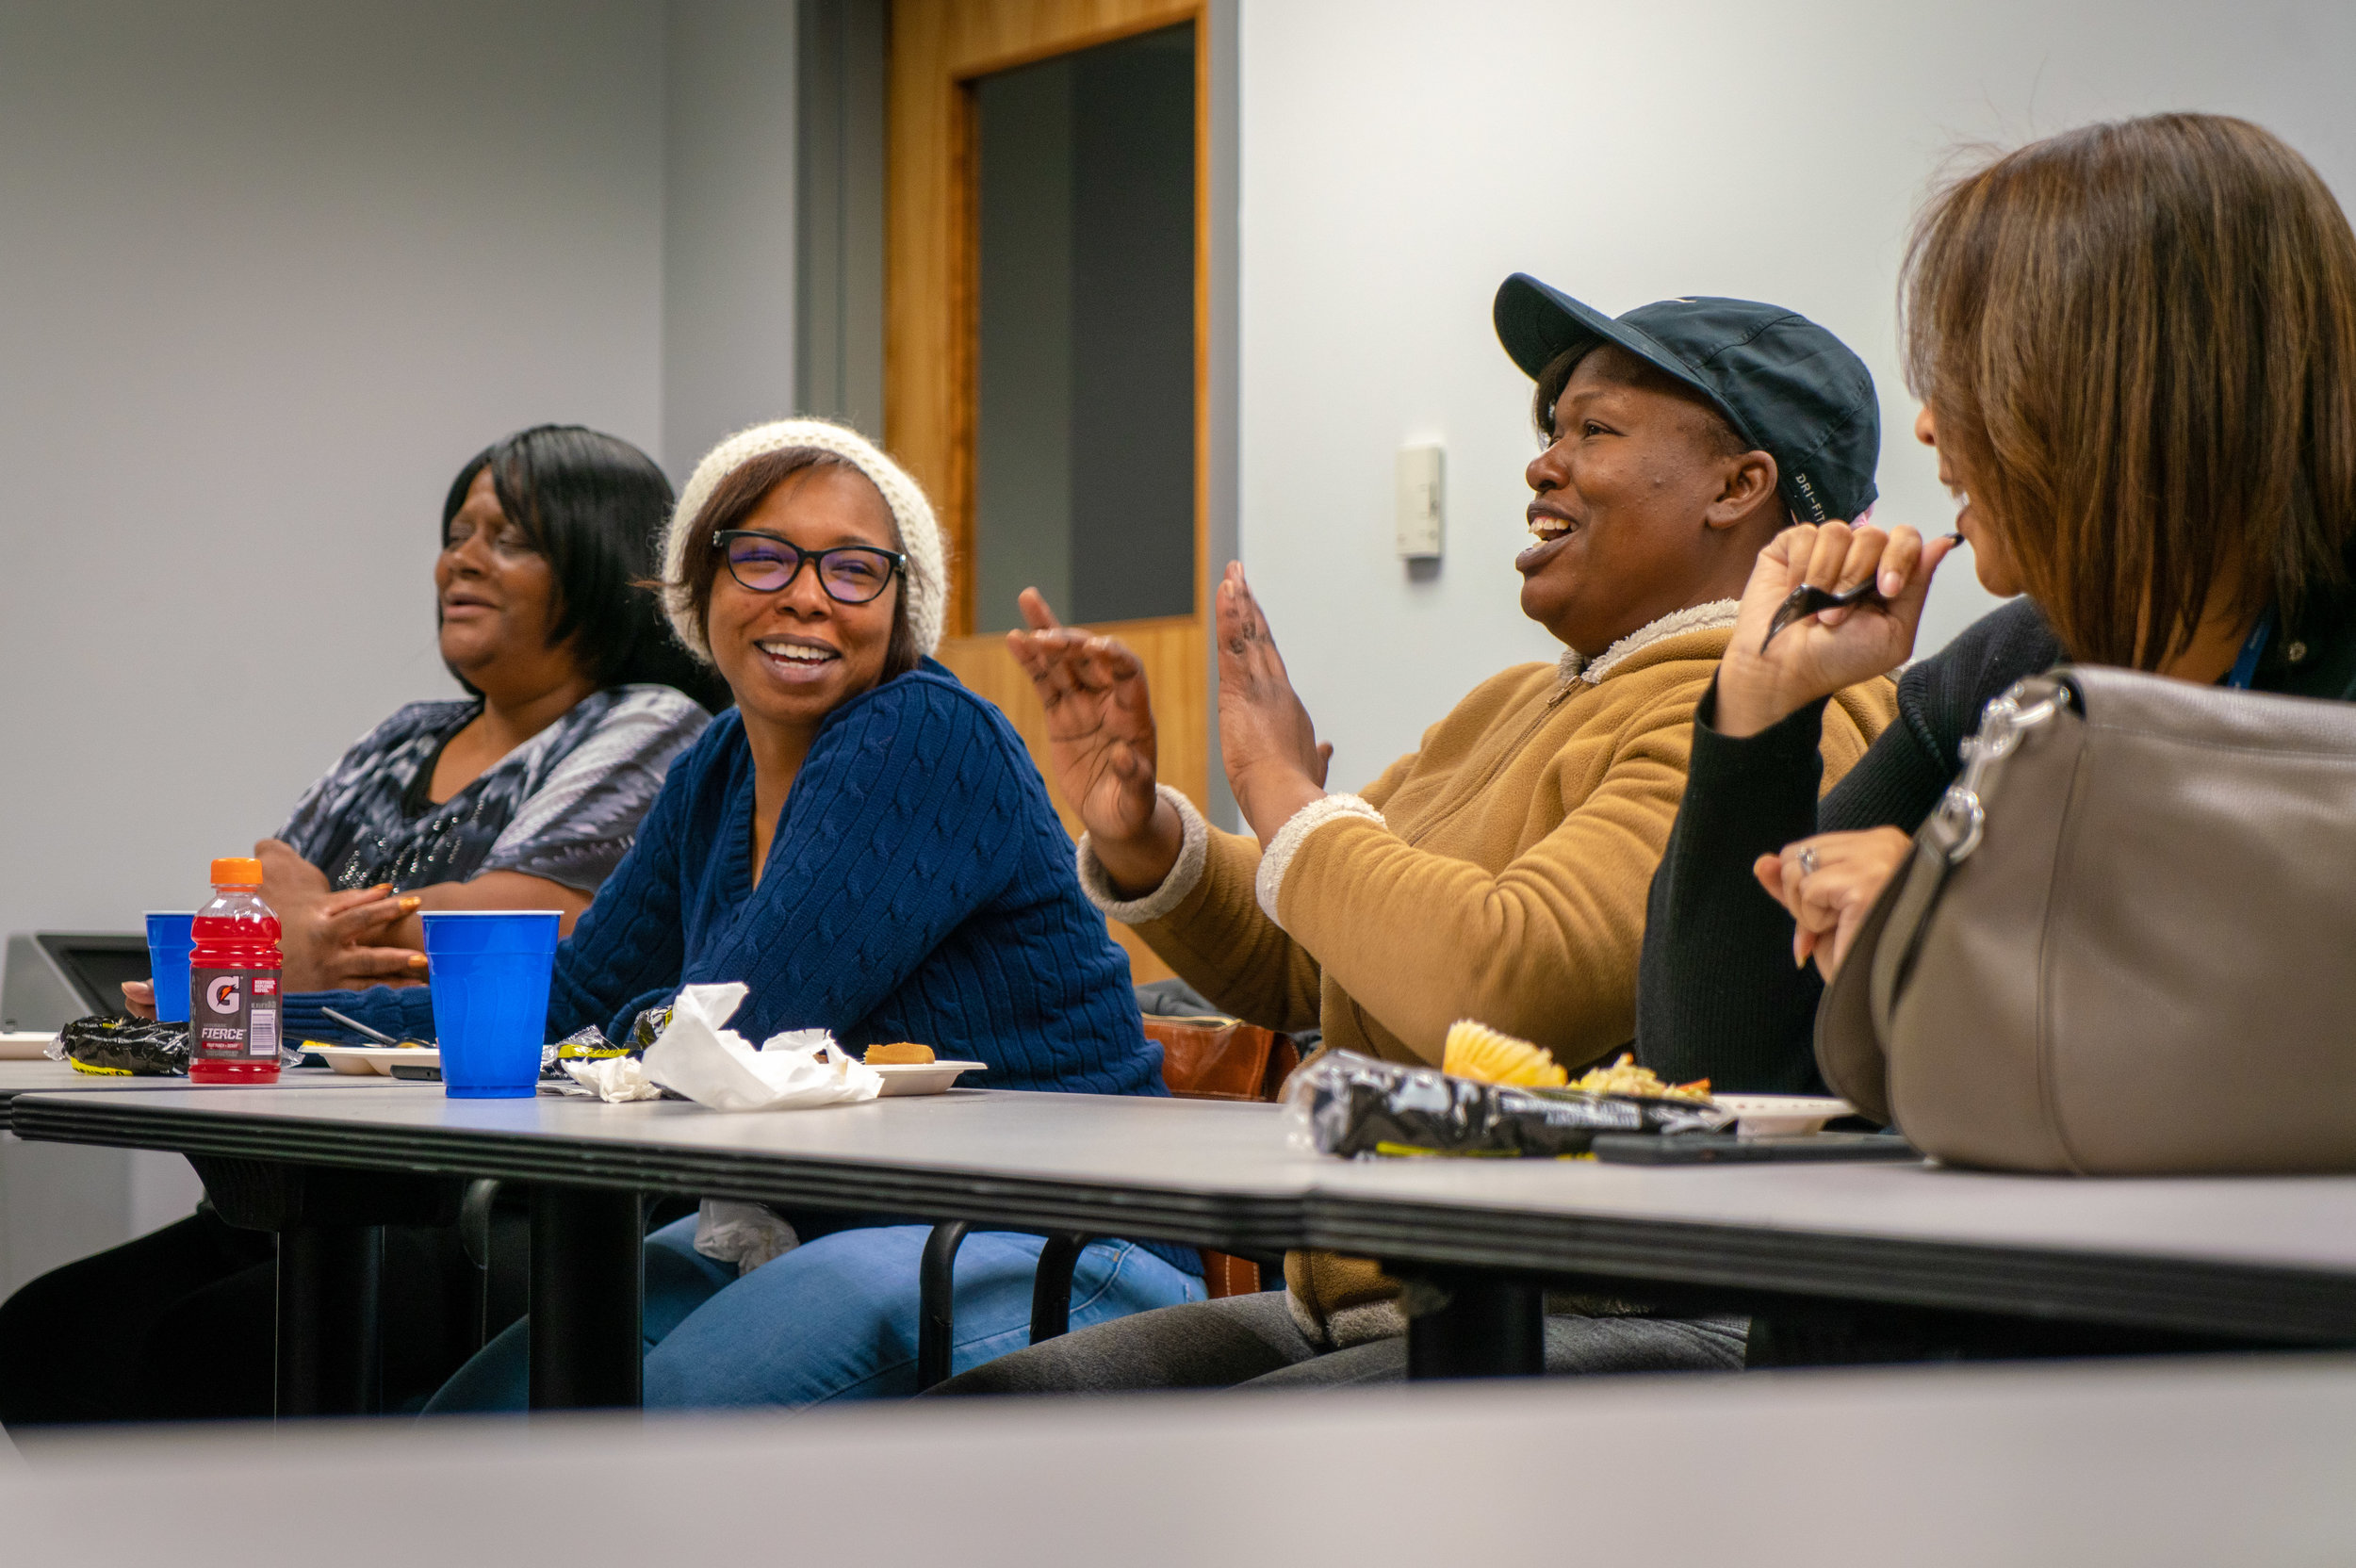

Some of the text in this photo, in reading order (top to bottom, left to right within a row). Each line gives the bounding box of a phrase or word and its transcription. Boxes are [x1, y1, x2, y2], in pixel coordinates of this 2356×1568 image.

[1795, 473, 1825, 522] DRI-FIT
[206, 975, 240, 1015] G
[202, 1027, 243, 1040] FIERCE
